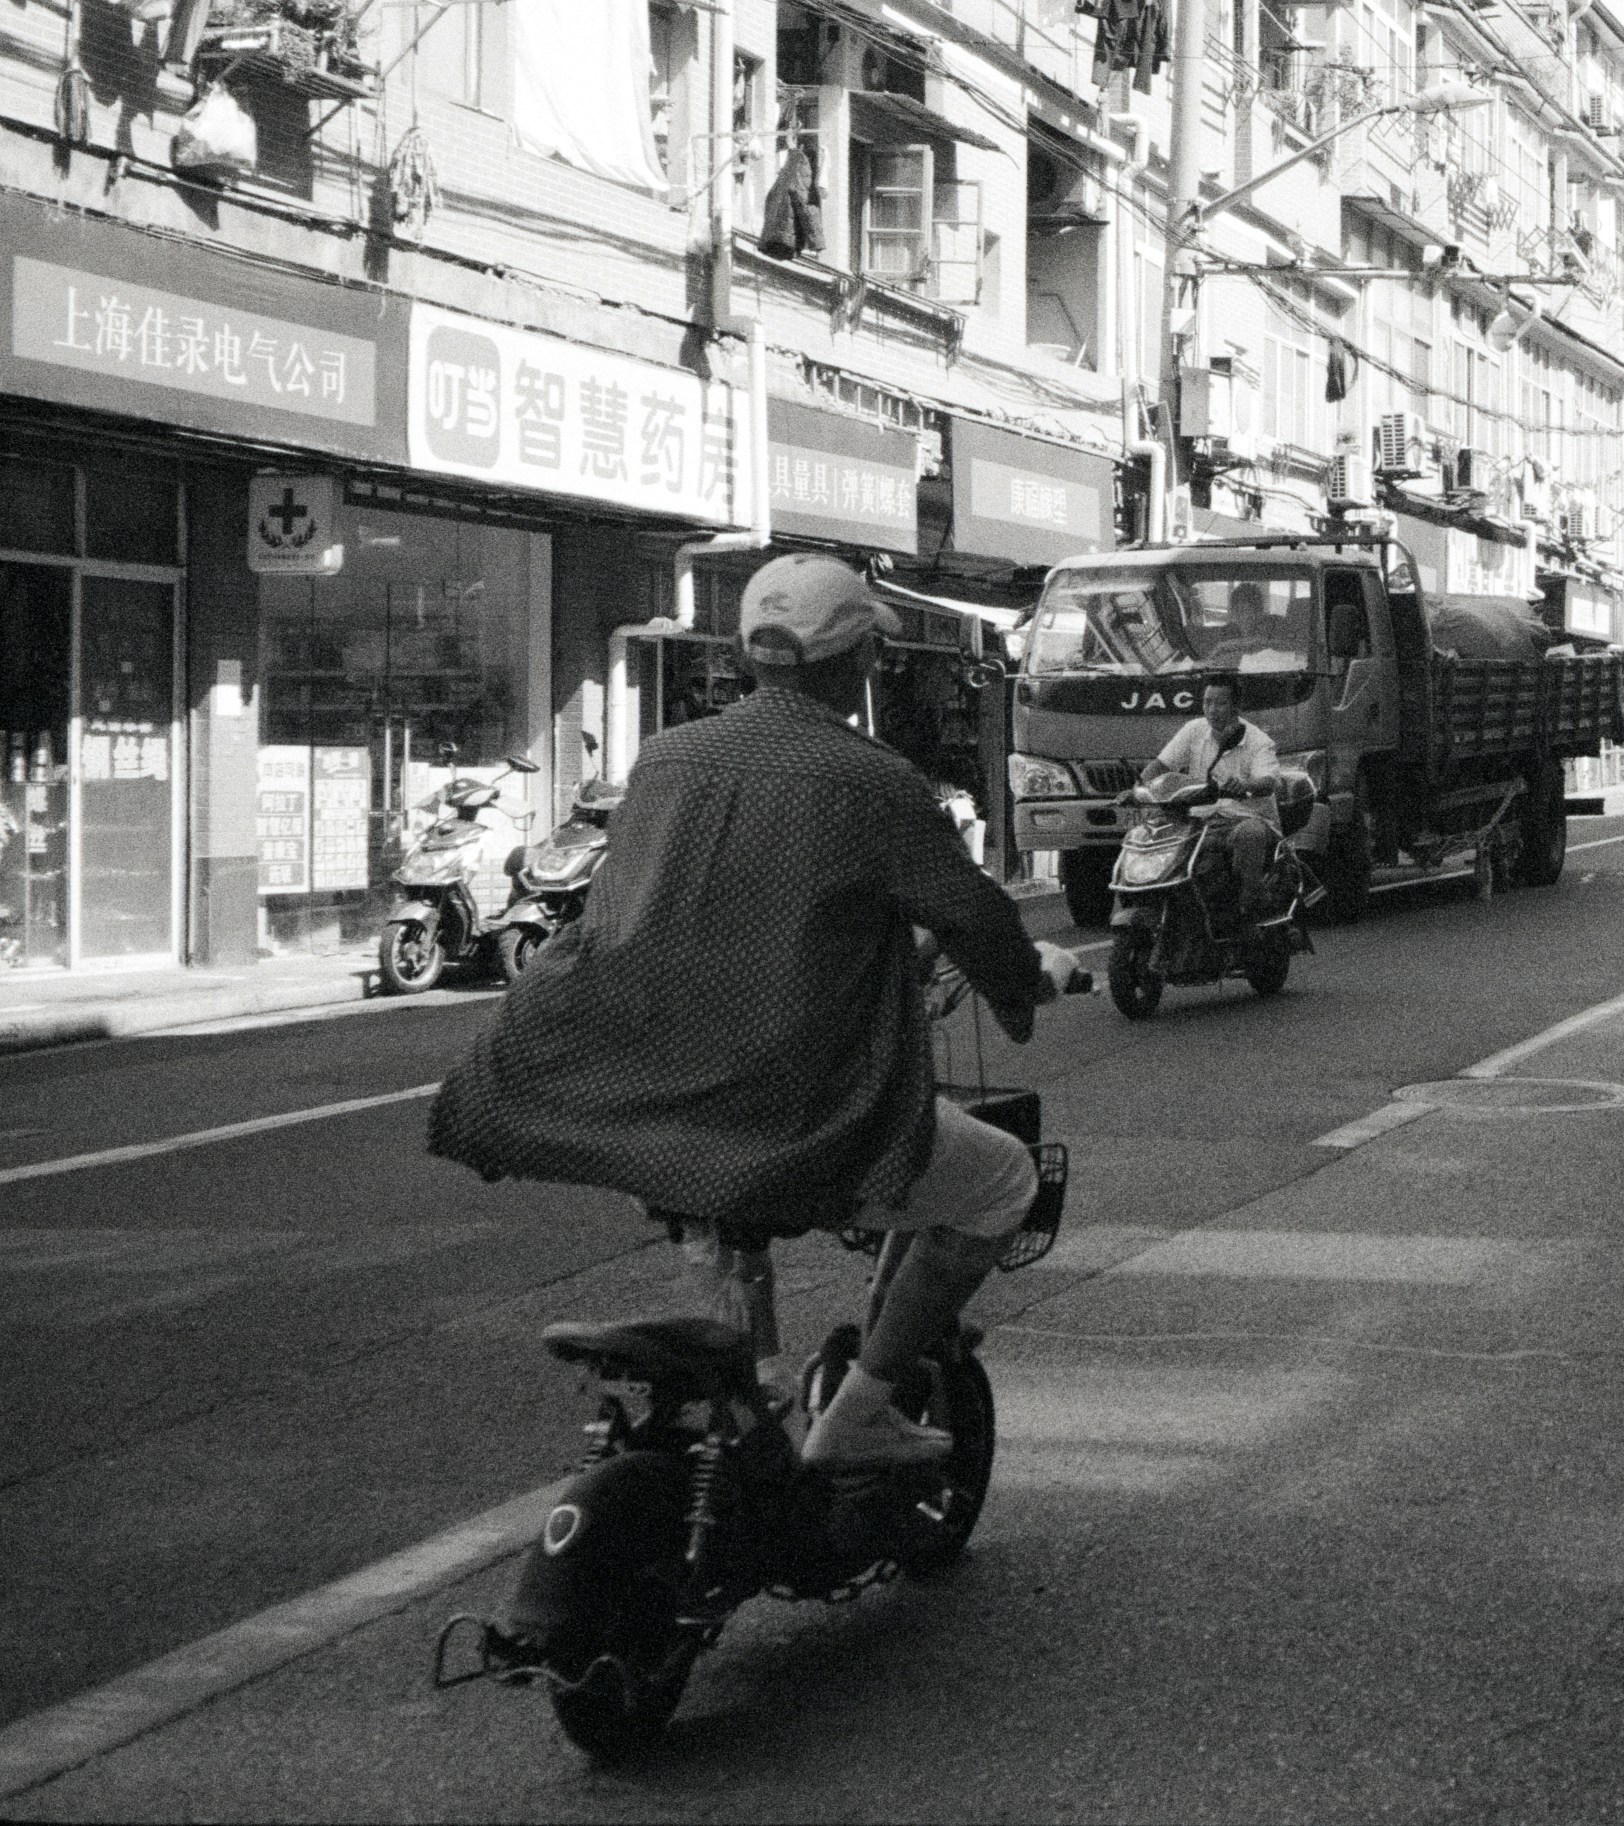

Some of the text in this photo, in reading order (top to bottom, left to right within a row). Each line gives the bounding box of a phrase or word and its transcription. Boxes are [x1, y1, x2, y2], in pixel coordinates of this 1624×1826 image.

[53, 286, 345, 404] 上海佳录电气公司
[428, 358, 738, 502] 叮当 智慧药房
[1121, 691, 1194, 709] JAC
